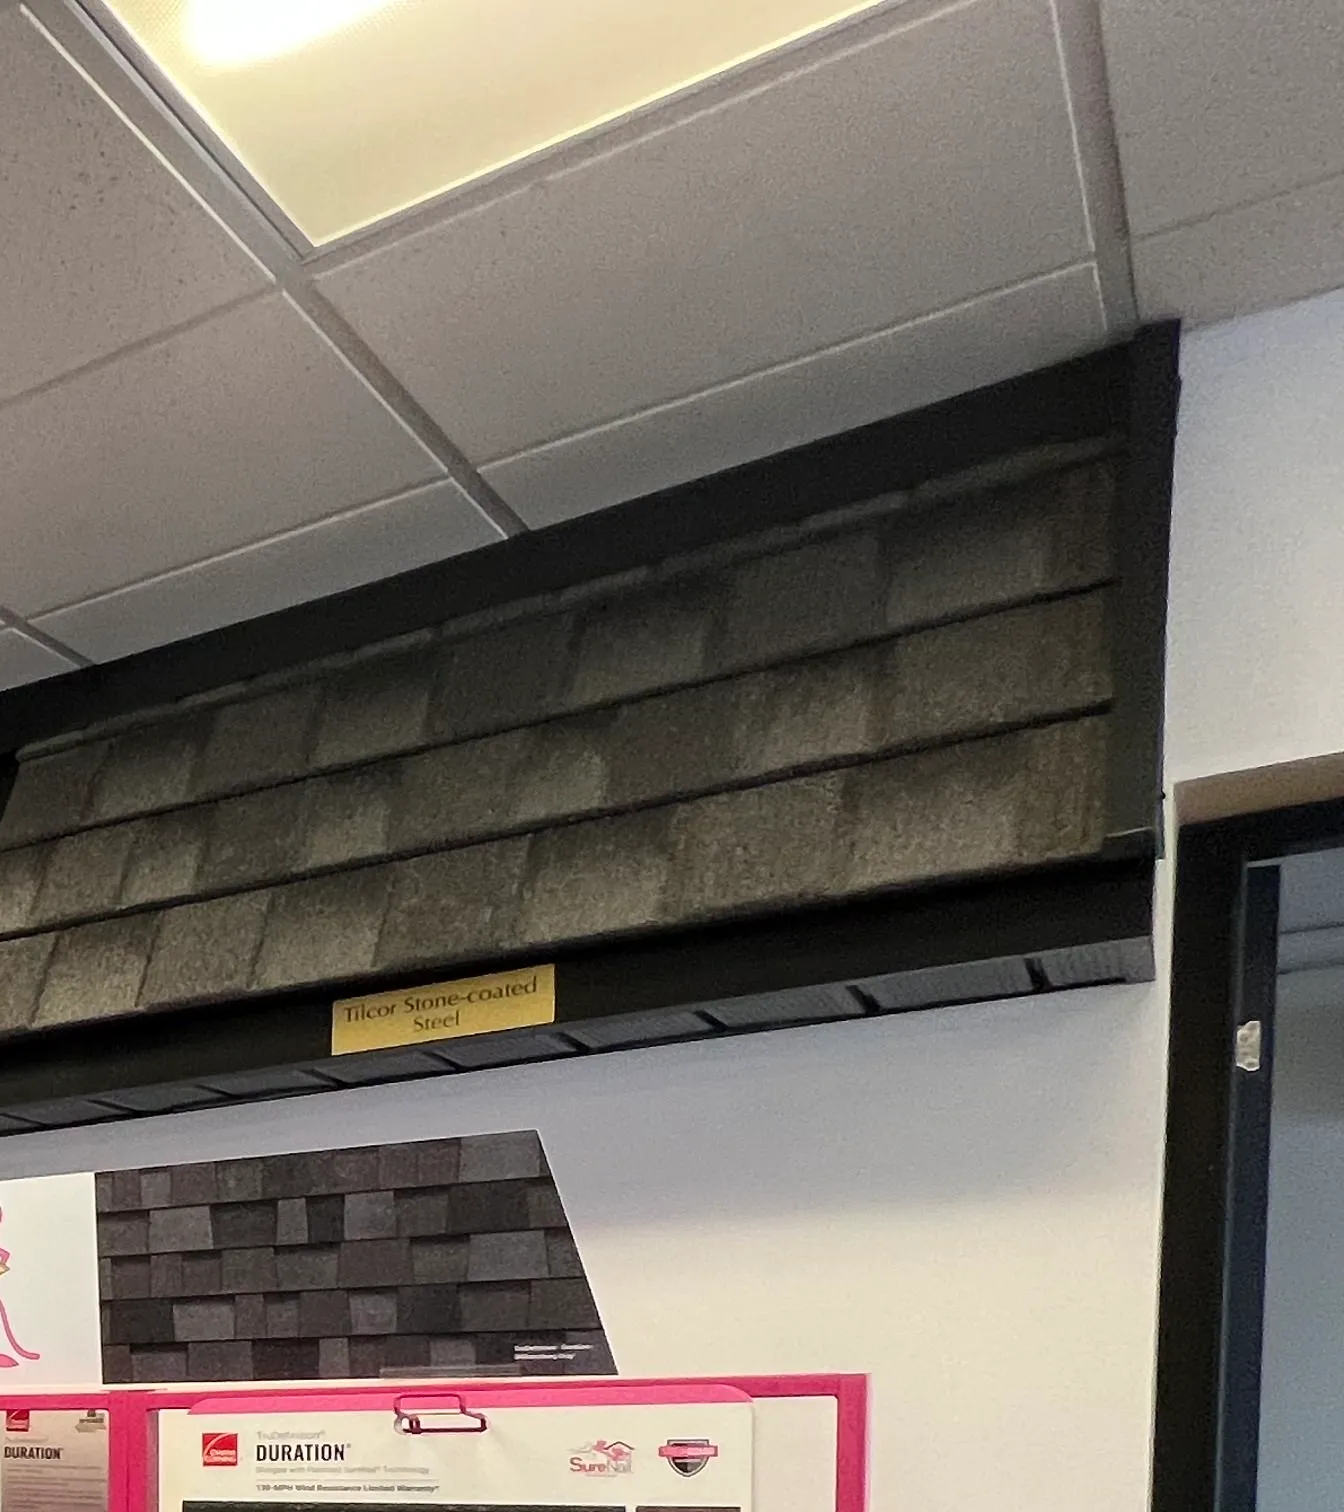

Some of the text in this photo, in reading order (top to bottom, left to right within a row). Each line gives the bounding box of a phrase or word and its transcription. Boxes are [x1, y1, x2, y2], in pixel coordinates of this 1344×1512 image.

[344, 975, 537, 1023] Tilcor Stone-coated
[413, 1010, 461, 1033] Steel
[3, 1446, 62, 1460] DURATION
[255, 1443, 346, 1462] DURATION
